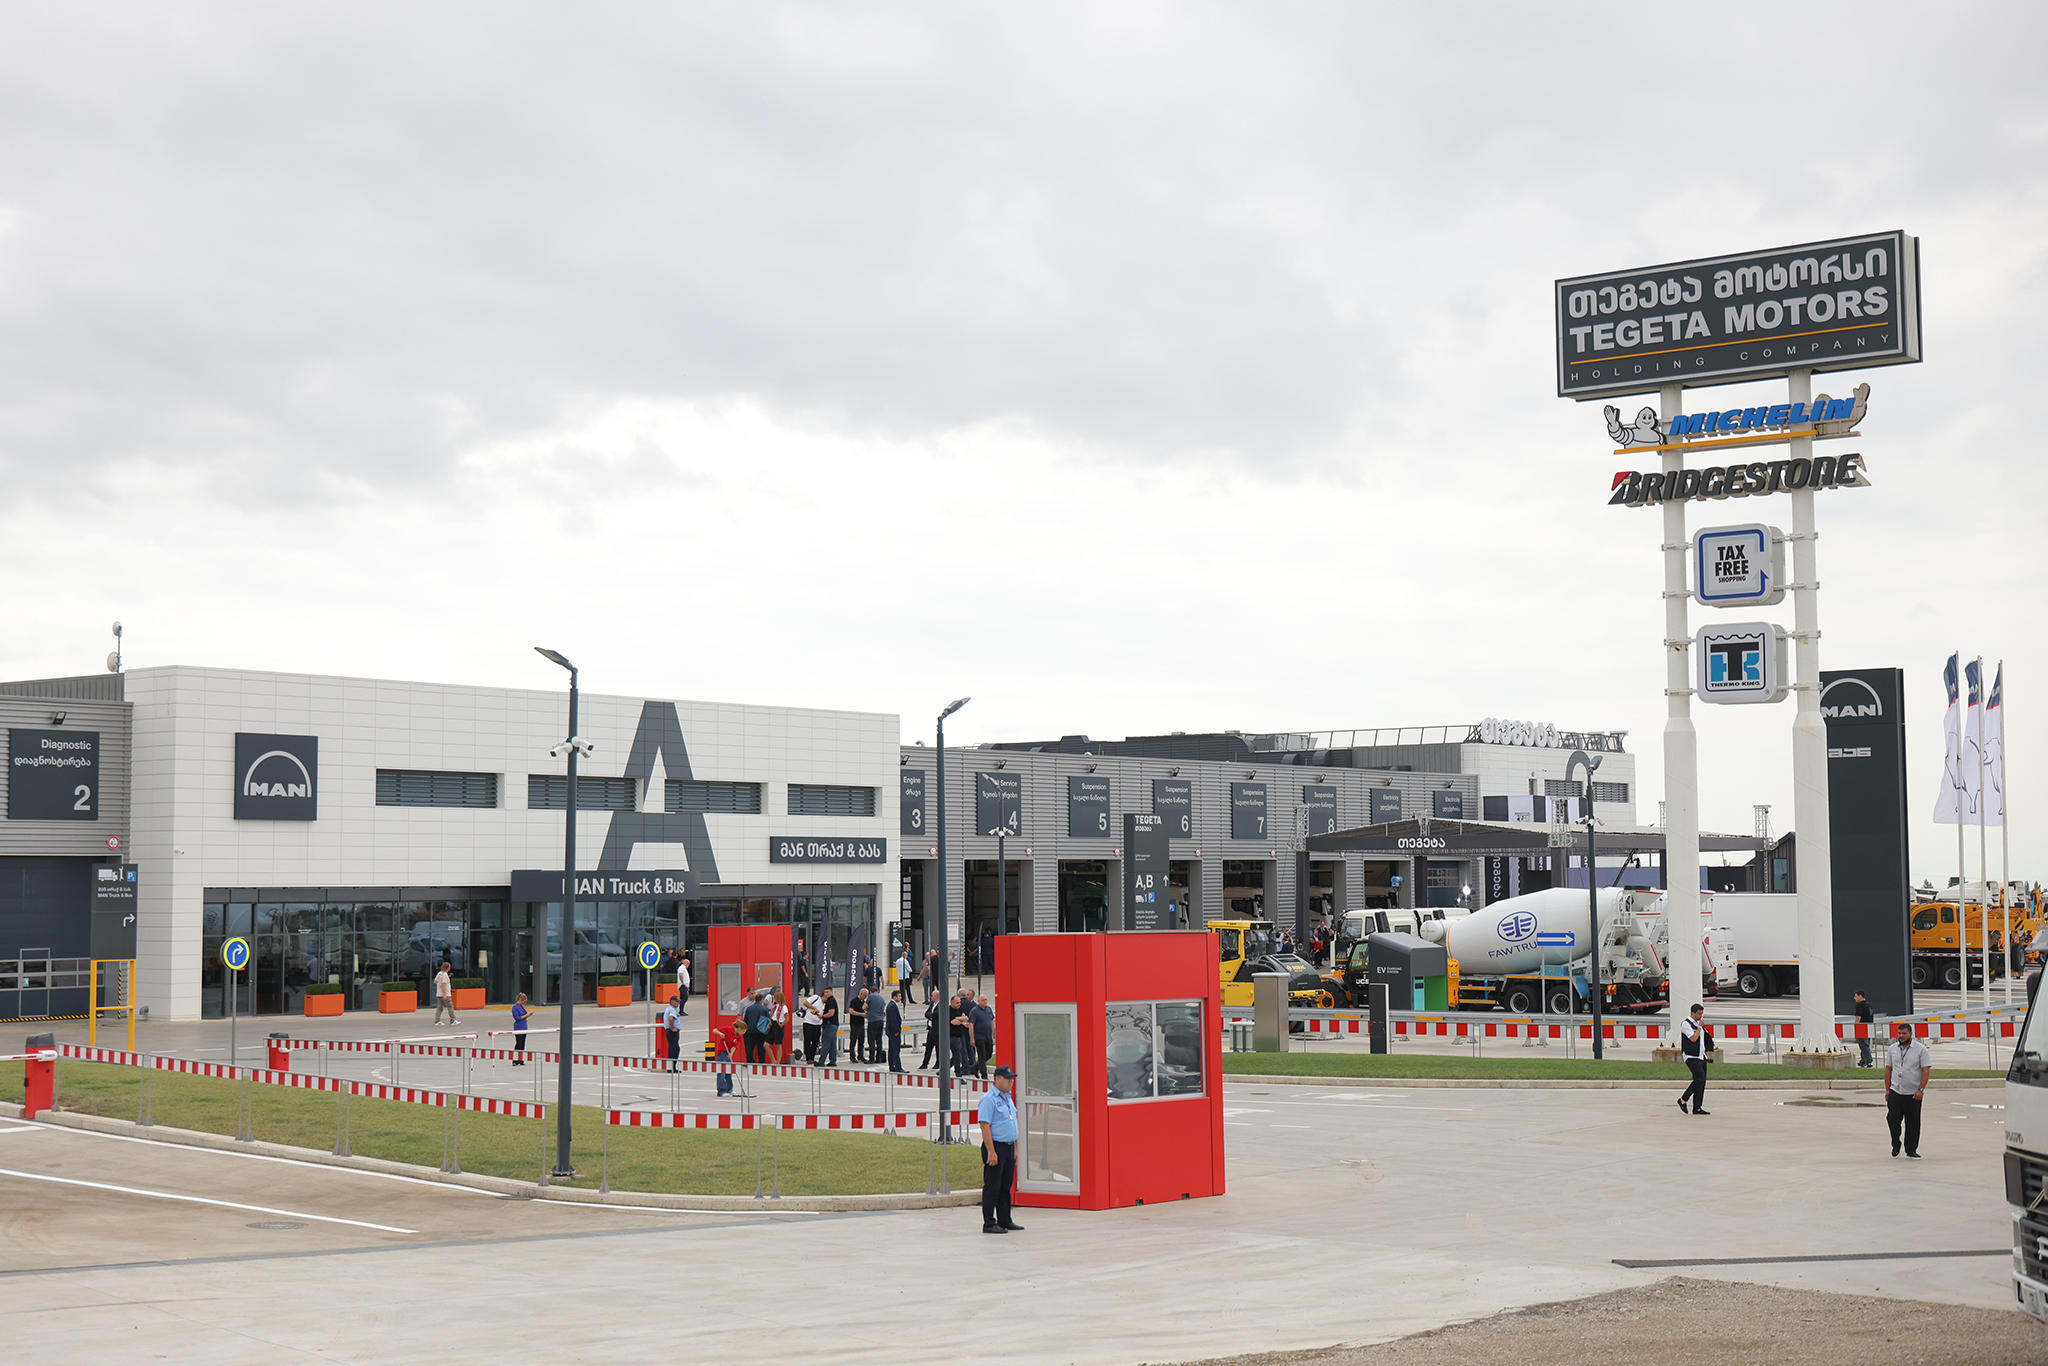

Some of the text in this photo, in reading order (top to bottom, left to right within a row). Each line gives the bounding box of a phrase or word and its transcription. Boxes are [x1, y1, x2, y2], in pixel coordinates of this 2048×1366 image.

[1568, 247, 1888, 319] თეგეტა მოტორსი
[1569, 285, 1889, 354] TEGETA MOTORS
[1570, 333, 1890, 382] HOLDING COMPANY
[1669, 397, 1856, 436] MICHELIN
[1607, 453, 1861, 506] BRIDGESTONE
[1717, 545, 1746, 561] TAX
[1715, 559, 1749, 577] FREE
[1718, 575, 1747, 584] SHOPPING
[1822, 704, 1876, 718] MAN
[41, 739, 92, 752] Diagnostic
[903, 776, 921, 786] Engine
[1081, 782, 1107, 791] Suspension
[73, 784, 91, 811] 2
[250, 782, 306, 798] MAN
[911, 808, 921, 829] 3
[1008, 810, 1018, 830] 4
[1098, 813, 1107, 831] 5
[1134, 815, 1162, 825] TEGETA
[1181, 815, 1189, 832] 6
[1257, 817, 1264, 833] 7
[1328, 818, 1335, 833] 8
[780, 842, 881, 859] მან თრაქ & ბას
[1398, 838, 1446, 849] თეგეტა
[609, 877, 651, 895] Truck
[654, 878, 663, 895] &
[666, 878, 685, 895] Bus
[1136, 875, 1154, 891] A,B
[1488, 946, 1514, 959] FAW
[1377, 966, 1386, 974] EV
